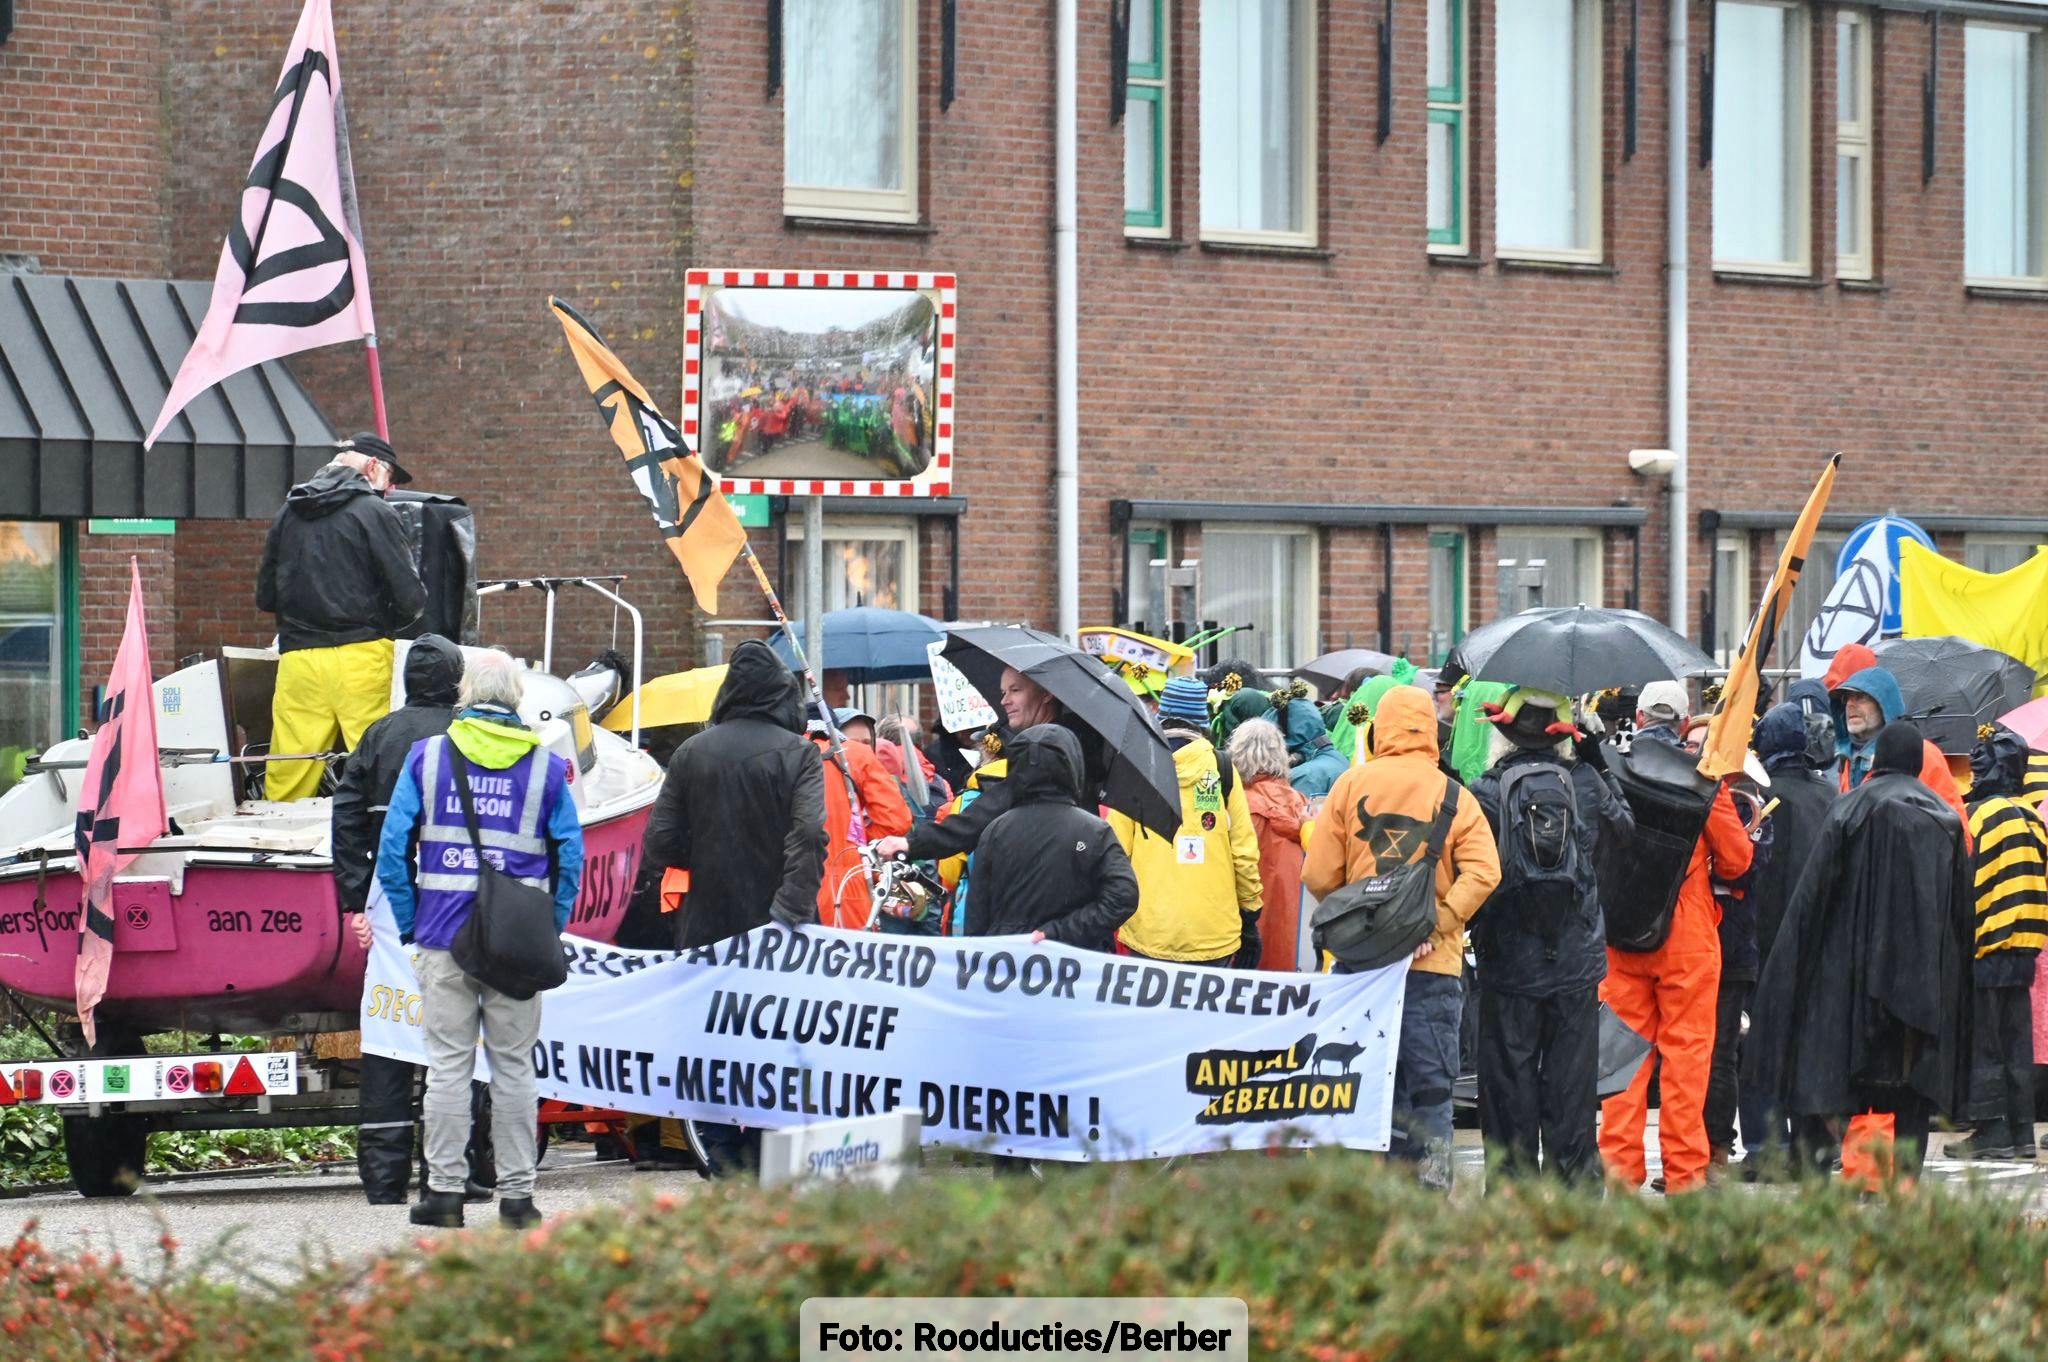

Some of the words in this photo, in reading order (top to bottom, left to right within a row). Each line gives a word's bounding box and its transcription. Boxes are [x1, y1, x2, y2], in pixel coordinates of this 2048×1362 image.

[446, 796, 512, 818] LIISON
[450, 775, 513, 796] LITIE
[0, 899, 82, 952] ersfoor
[208, 909, 251, 932] aan
[260, 909, 302, 933] zee
[956, 951, 1081, 999] VOOR
[1096, 963, 1320, 1017] IEDEREEN,
[704, 990, 899, 1051] INCLUSIEF
[531, 1038, 568, 1084] DE
[578, 1044, 902, 1118] NIET-MENSELIJKE
[919, 1081, 1070, 1139] DIEREN
[1088, 1096, 1100, 1142] !
[808, 1139, 880, 1177] syngenta
